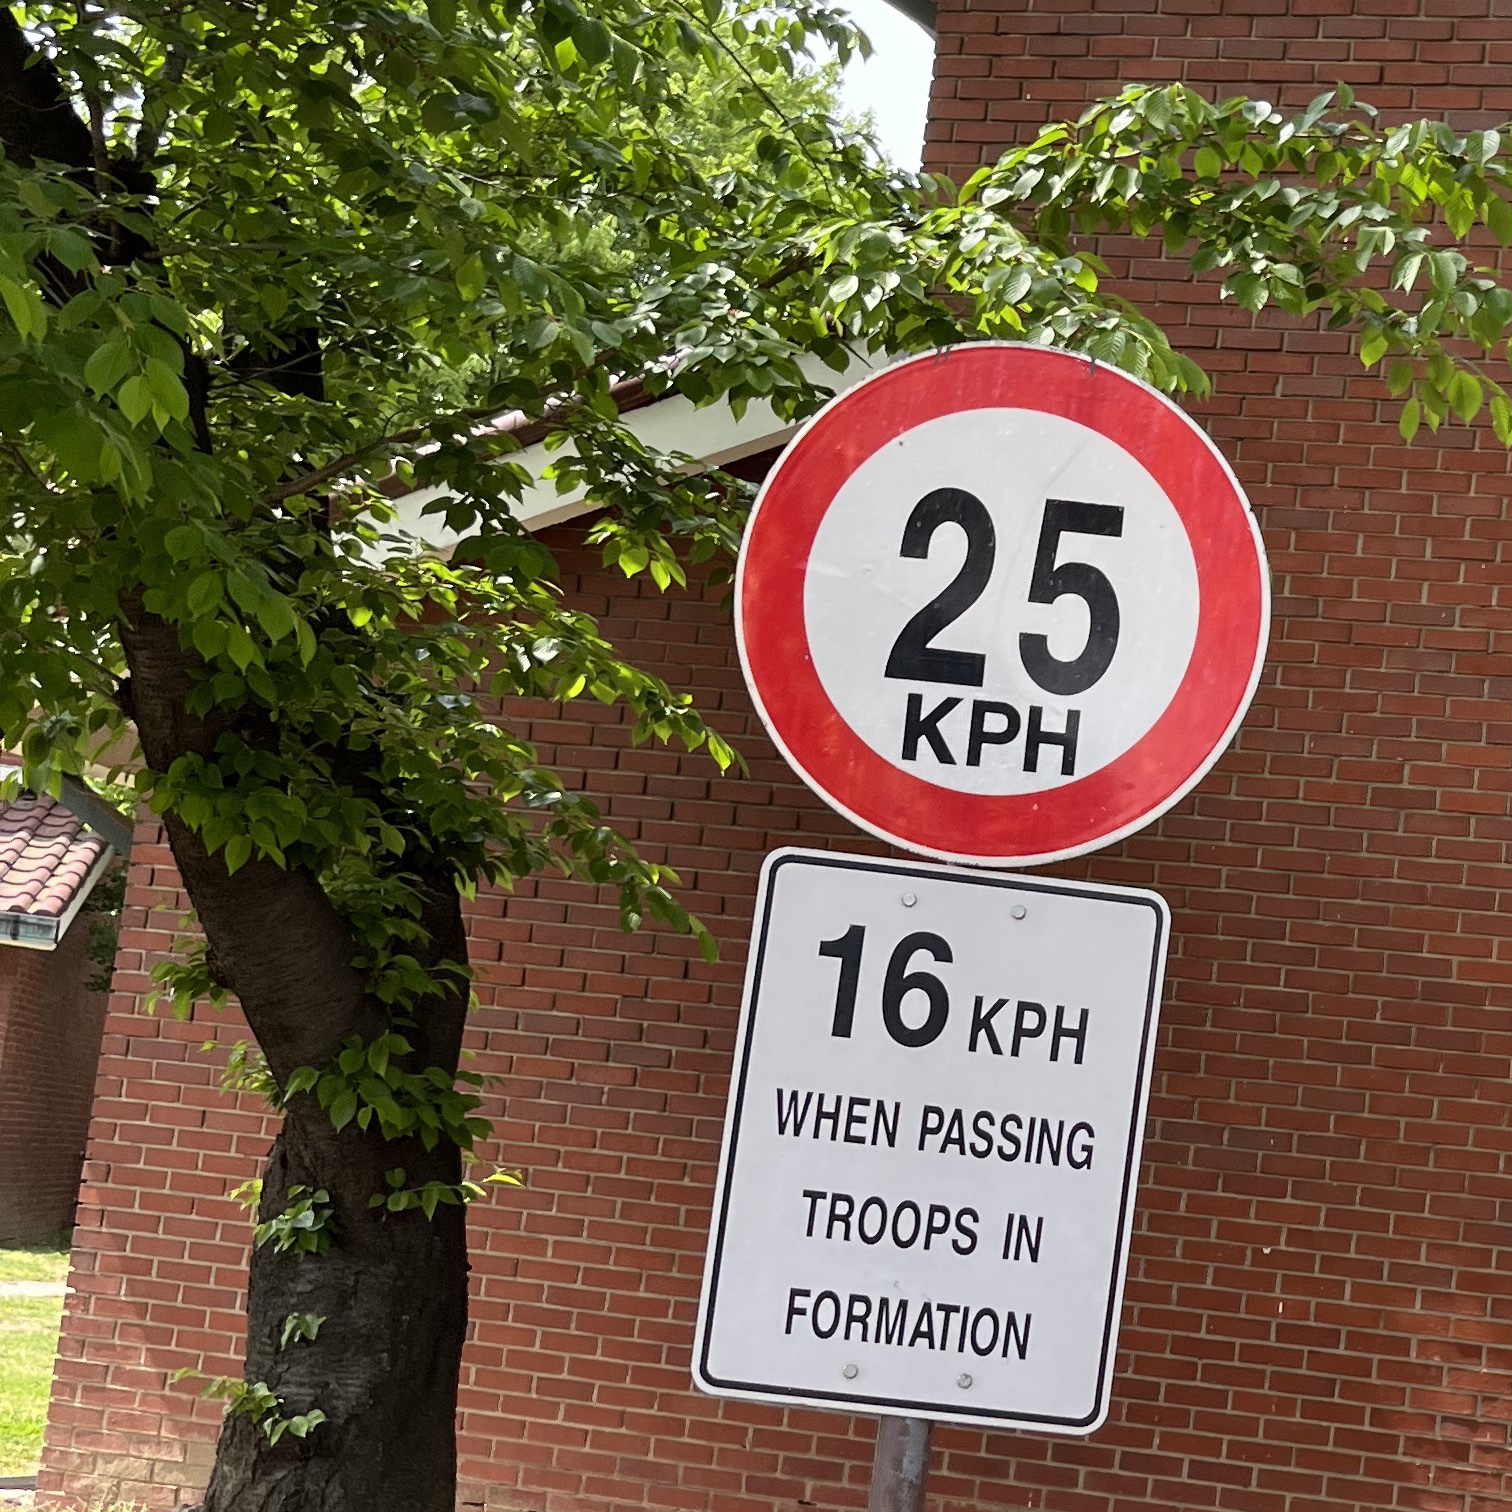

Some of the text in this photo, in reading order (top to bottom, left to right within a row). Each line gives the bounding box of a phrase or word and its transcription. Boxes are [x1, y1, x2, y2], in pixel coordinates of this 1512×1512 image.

[883, 487, 1125, 696] 25
[901, 692, 1081, 777] KPH
[818, 924, 1090, 1065] 16 KPH
[776, 1087, 1096, 1171] WHEN PASSING
[802, 1189, 1044, 1264] TROOPS IN
[784, 1287, 1032, 1361] FORMATION
